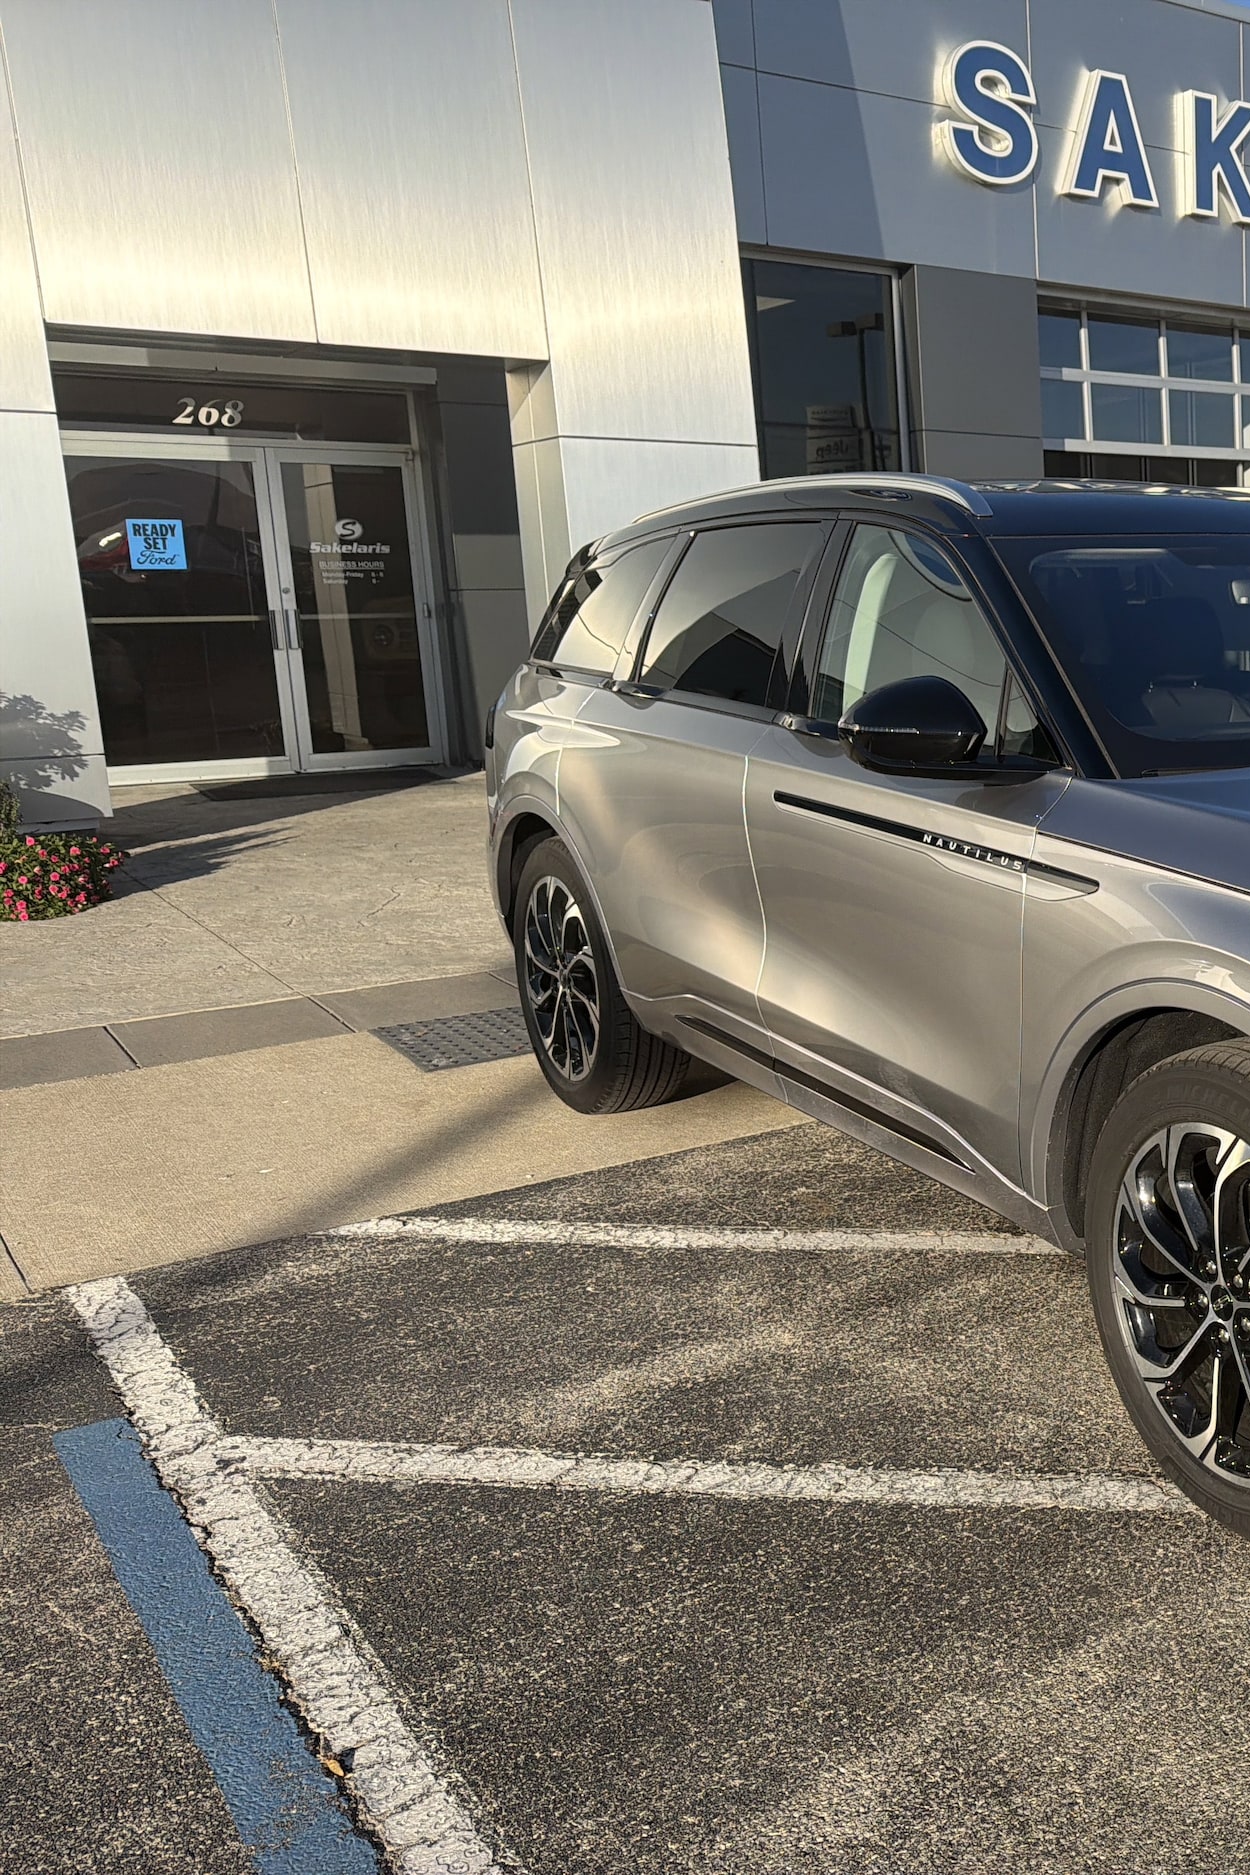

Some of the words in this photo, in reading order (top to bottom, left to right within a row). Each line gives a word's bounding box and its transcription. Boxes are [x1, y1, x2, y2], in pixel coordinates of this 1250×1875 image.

[172, 397, 244, 427] 268
[132, 523, 176, 537] READY
[143, 537, 168, 550] SET
[309, 541, 391, 553] Sakelaris
[137, 550, 176, 565] Ford
[358, 561, 385, 569] HOURS
[923, 834, 1023, 870] NAUTILUS
